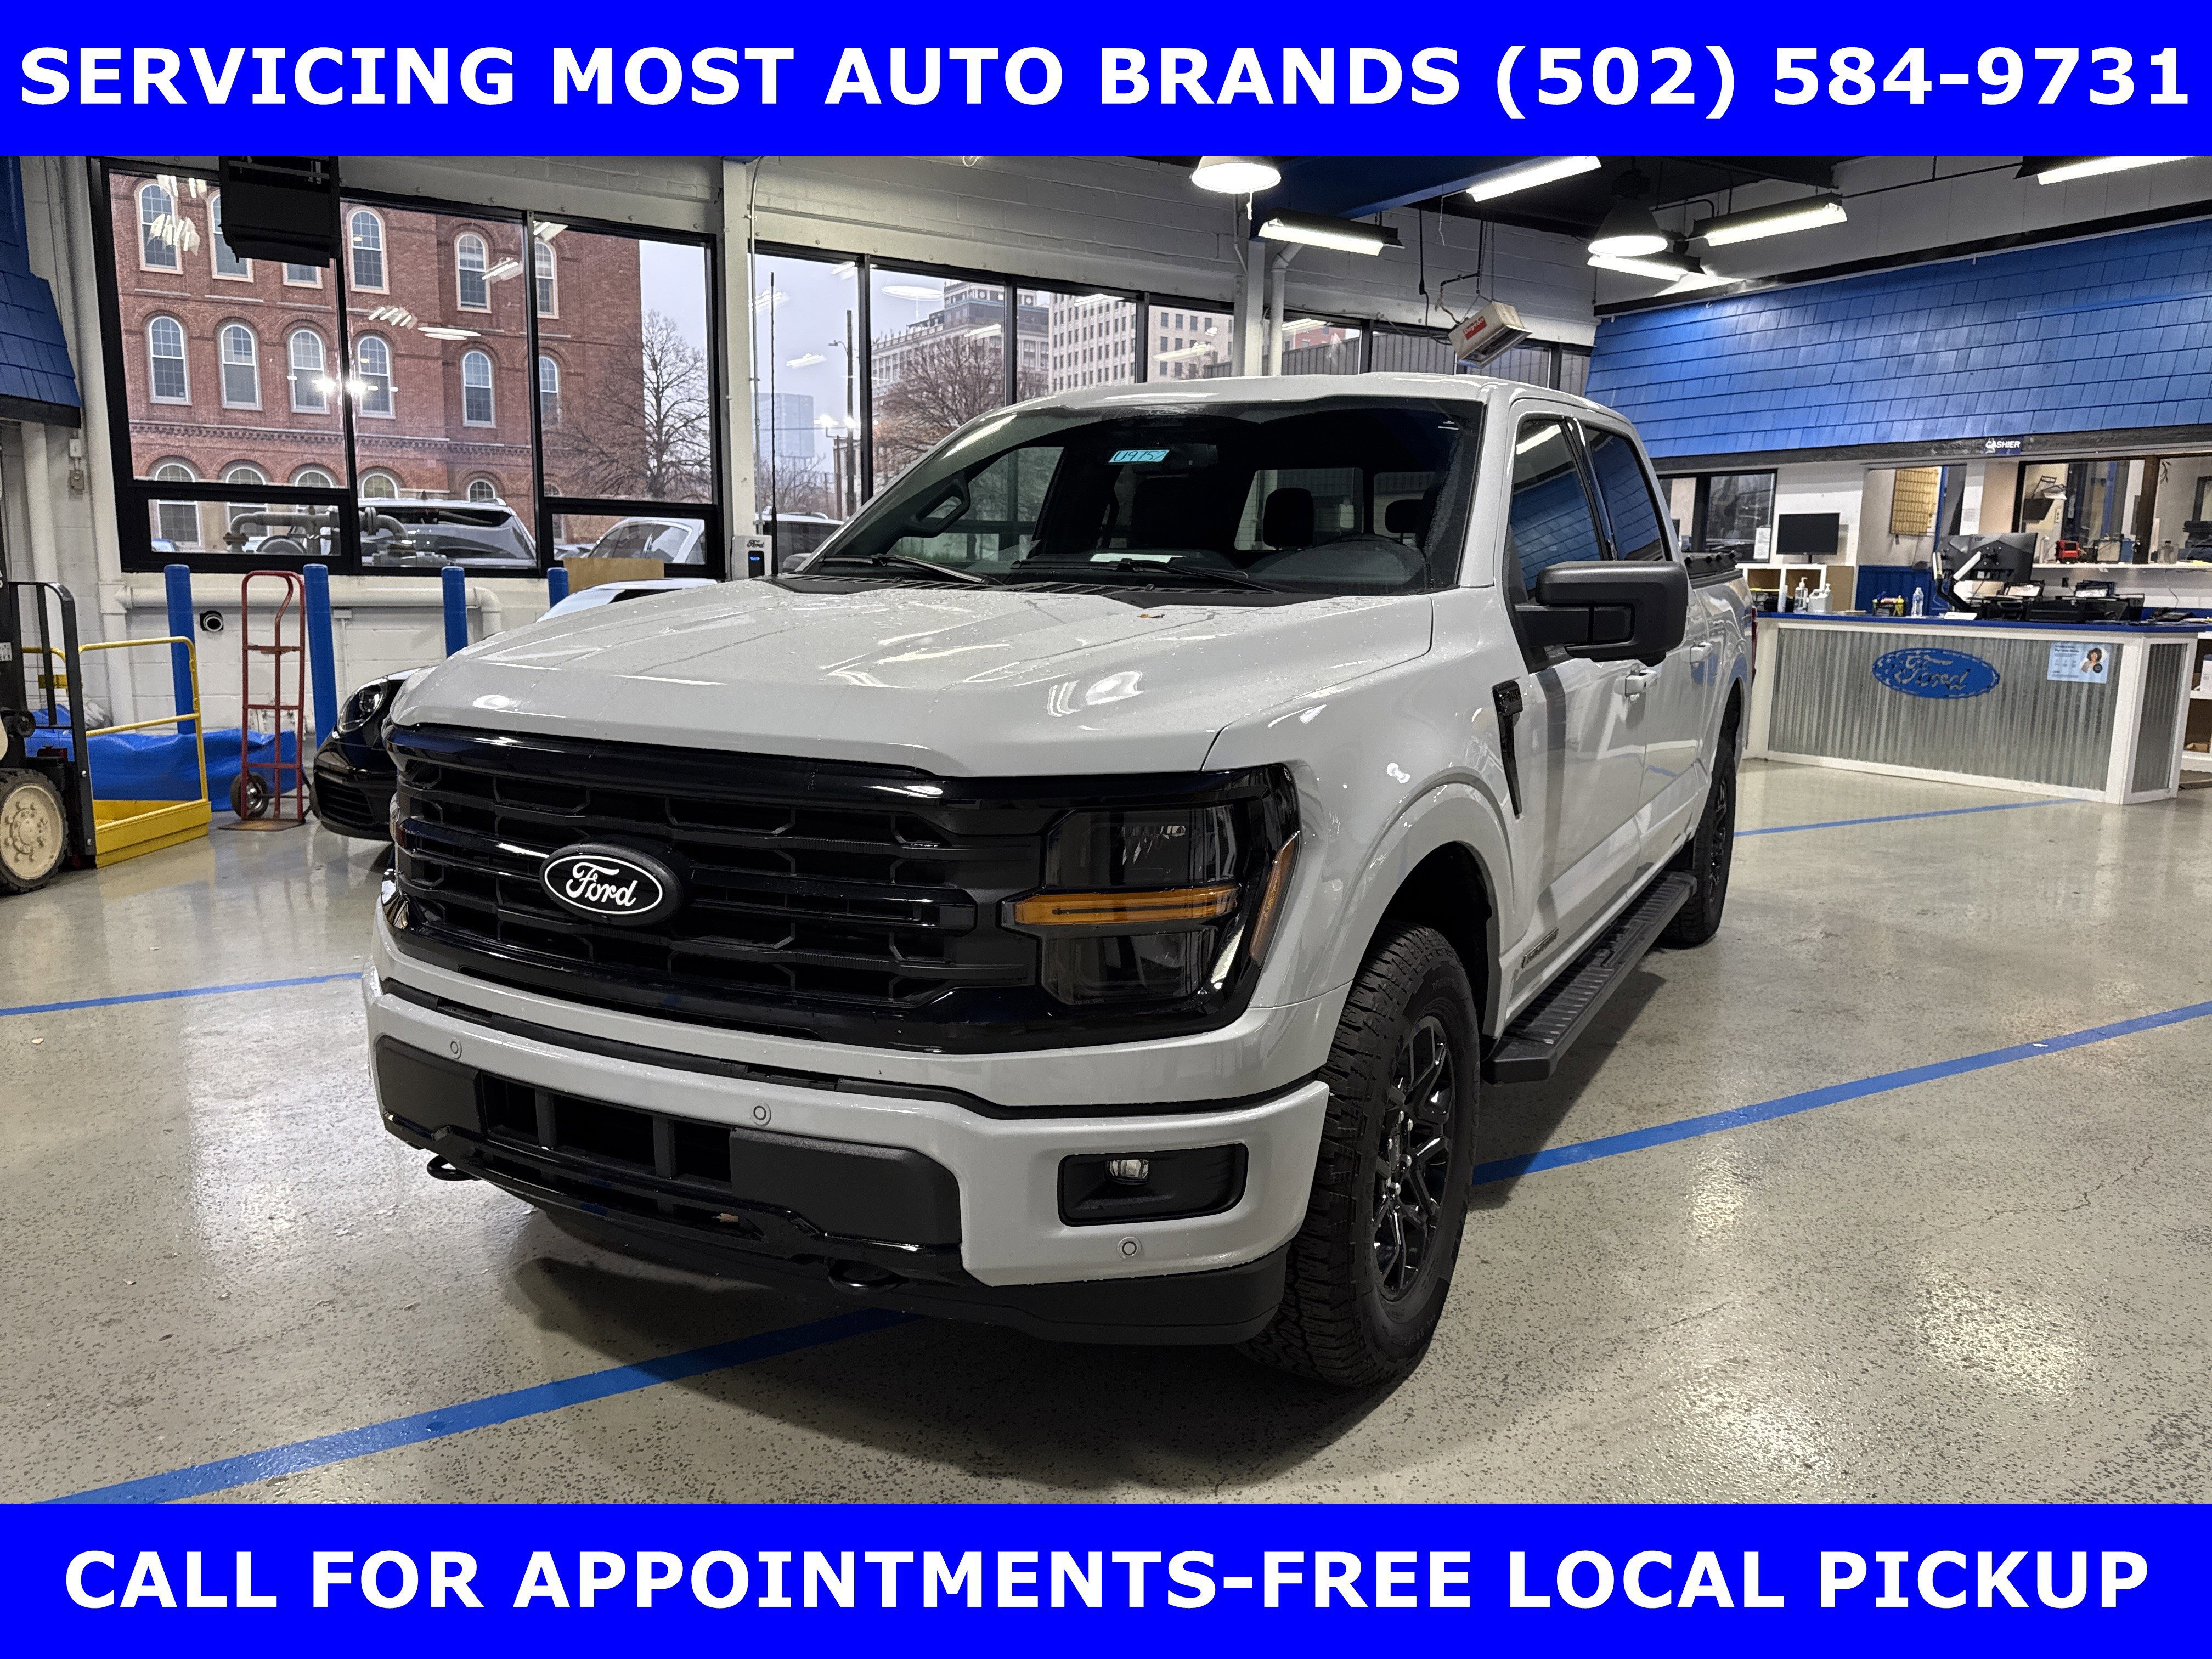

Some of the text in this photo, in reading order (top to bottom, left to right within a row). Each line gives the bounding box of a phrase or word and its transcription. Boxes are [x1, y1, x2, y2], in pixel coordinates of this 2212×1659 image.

[1463, 317, 1485, 335] Dayton
[1985, 440, 2021, 449] CASHIER
[1113, 450, 1167, 461] U9752
[747, 539, 765, 548] Ford
[1894, 654, 1971, 690] Ford
[566, 861, 639, 907] Ford
